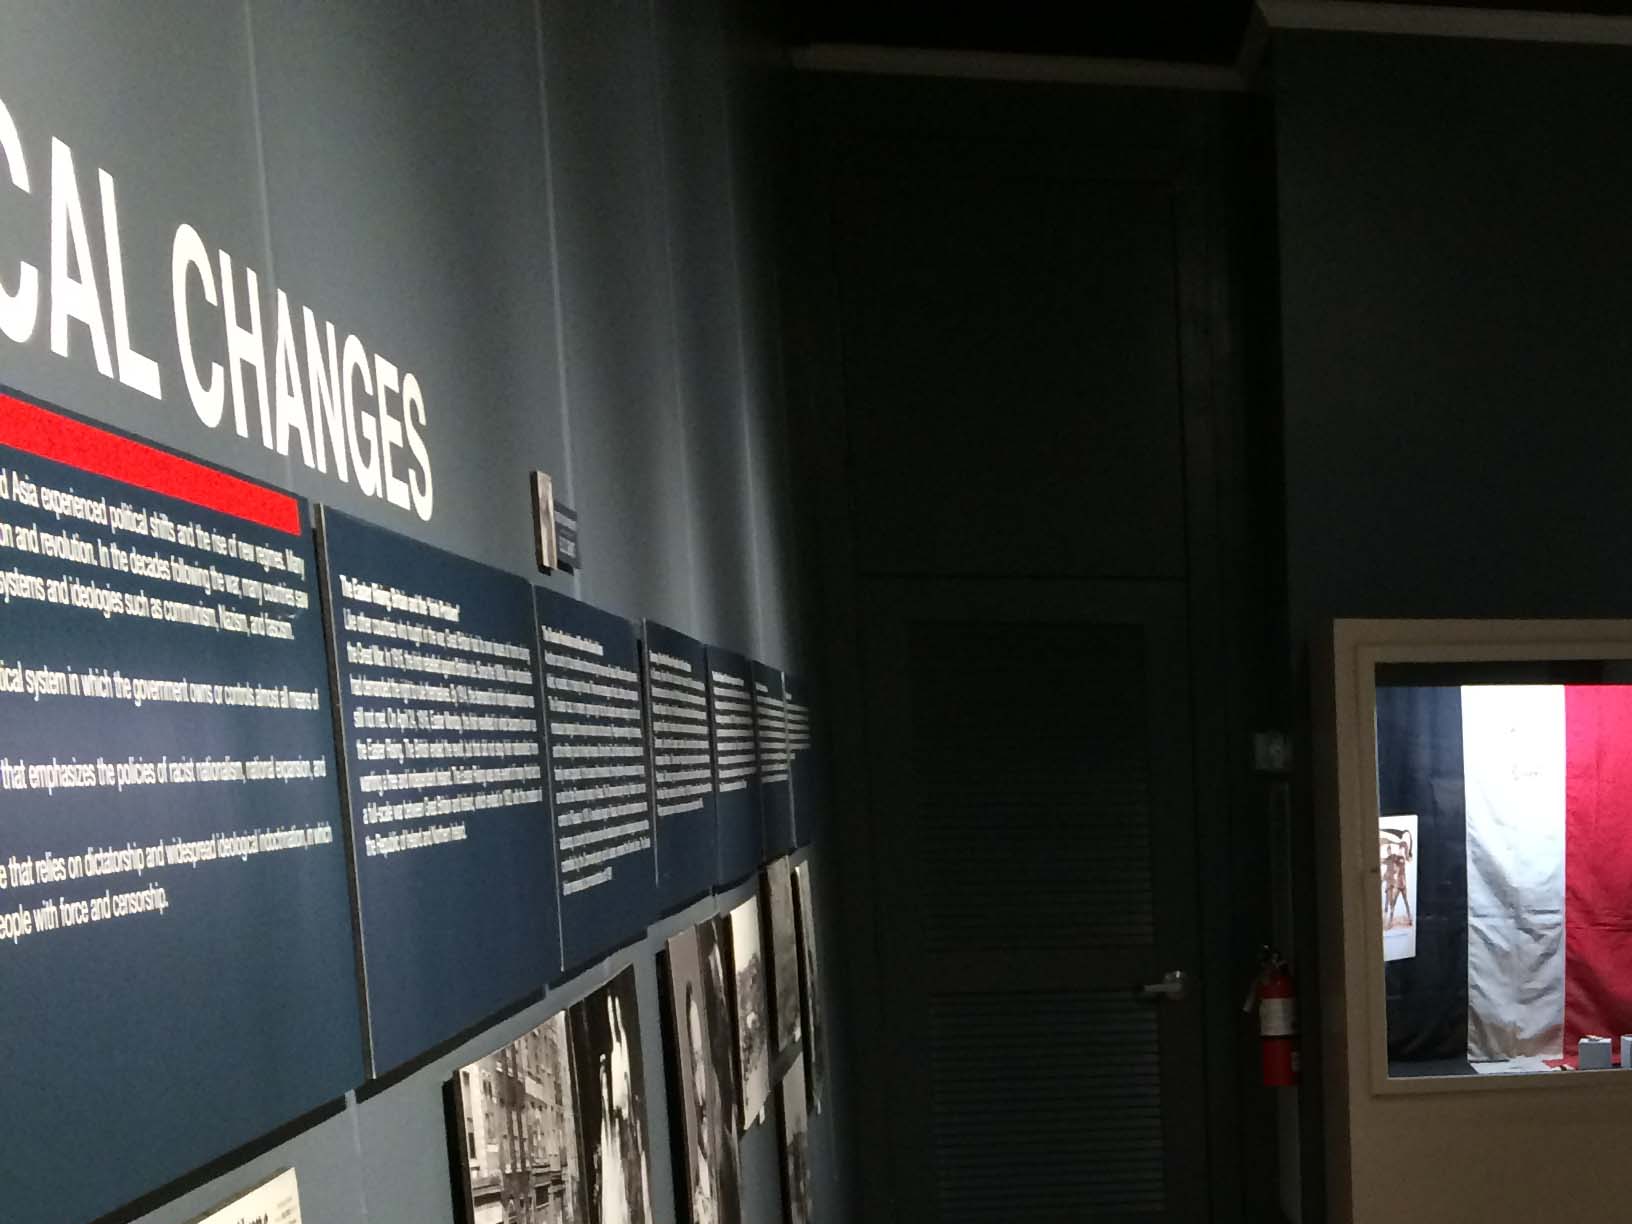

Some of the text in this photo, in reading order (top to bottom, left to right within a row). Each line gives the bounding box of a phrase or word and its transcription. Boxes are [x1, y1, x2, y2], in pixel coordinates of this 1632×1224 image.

[172, 224, 435, 522] CHANGES
[12, 470, 39, 508] Asia
[41, 487, 108, 525] experienced
[109, 501, 149, 535] political
[150, 511, 176, 542] shifts
[177, 521, 195, 547] and
[195, 524, 211, 551] the
[211, 528, 228, 555] rise
[227, 533, 238, 558] of
[15, 523, 40, 554] and
[40, 529, 98, 566] revolution.
[97, 538, 111, 568] In
[111, 542, 129, 572] the
[130, 546, 171, 581] decades
[171, 555, 211, 596] following
[210, 565, 225, 592] the
[46, 575, 70, 605] and
[69, 576, 124, 619] ideologies
[124, 589, 151, 617] such
[150, 597, 163, 619] as
[163, 600, 220, 632] communism,
[25, 665, 68, 702] system
[67, 665, 81, 696] in
[80, 667, 114, 698] which
[113, 670, 132, 699] the
[132, 677, 190, 707] government
[190, 682, 214, 704] owns
[214, 684, 224, 705] or
[0, 757, 27, 789] that
[29, 757, 97, 796] emphasizes
[97, 757, 116, 786] the
[117, 756, 157, 792] policies
[157, 755, 168, 784] of
[168, 755, 195, 783] racist
[8, 855, 35, 887] that
[35, 851, 67, 884] relies
[68, 855, 84, 880] on
[84, 841, 145, 877] dictatorship
[145, 839, 165, 868] and
[164, 833, 217, 869] widespread
[216, 828, 259, 862] ideological
[33, 898, 60, 932] with
[59, 897, 89, 927] force
[90, 889, 112, 921] and
[112, 881, 169, 915] censorship.
